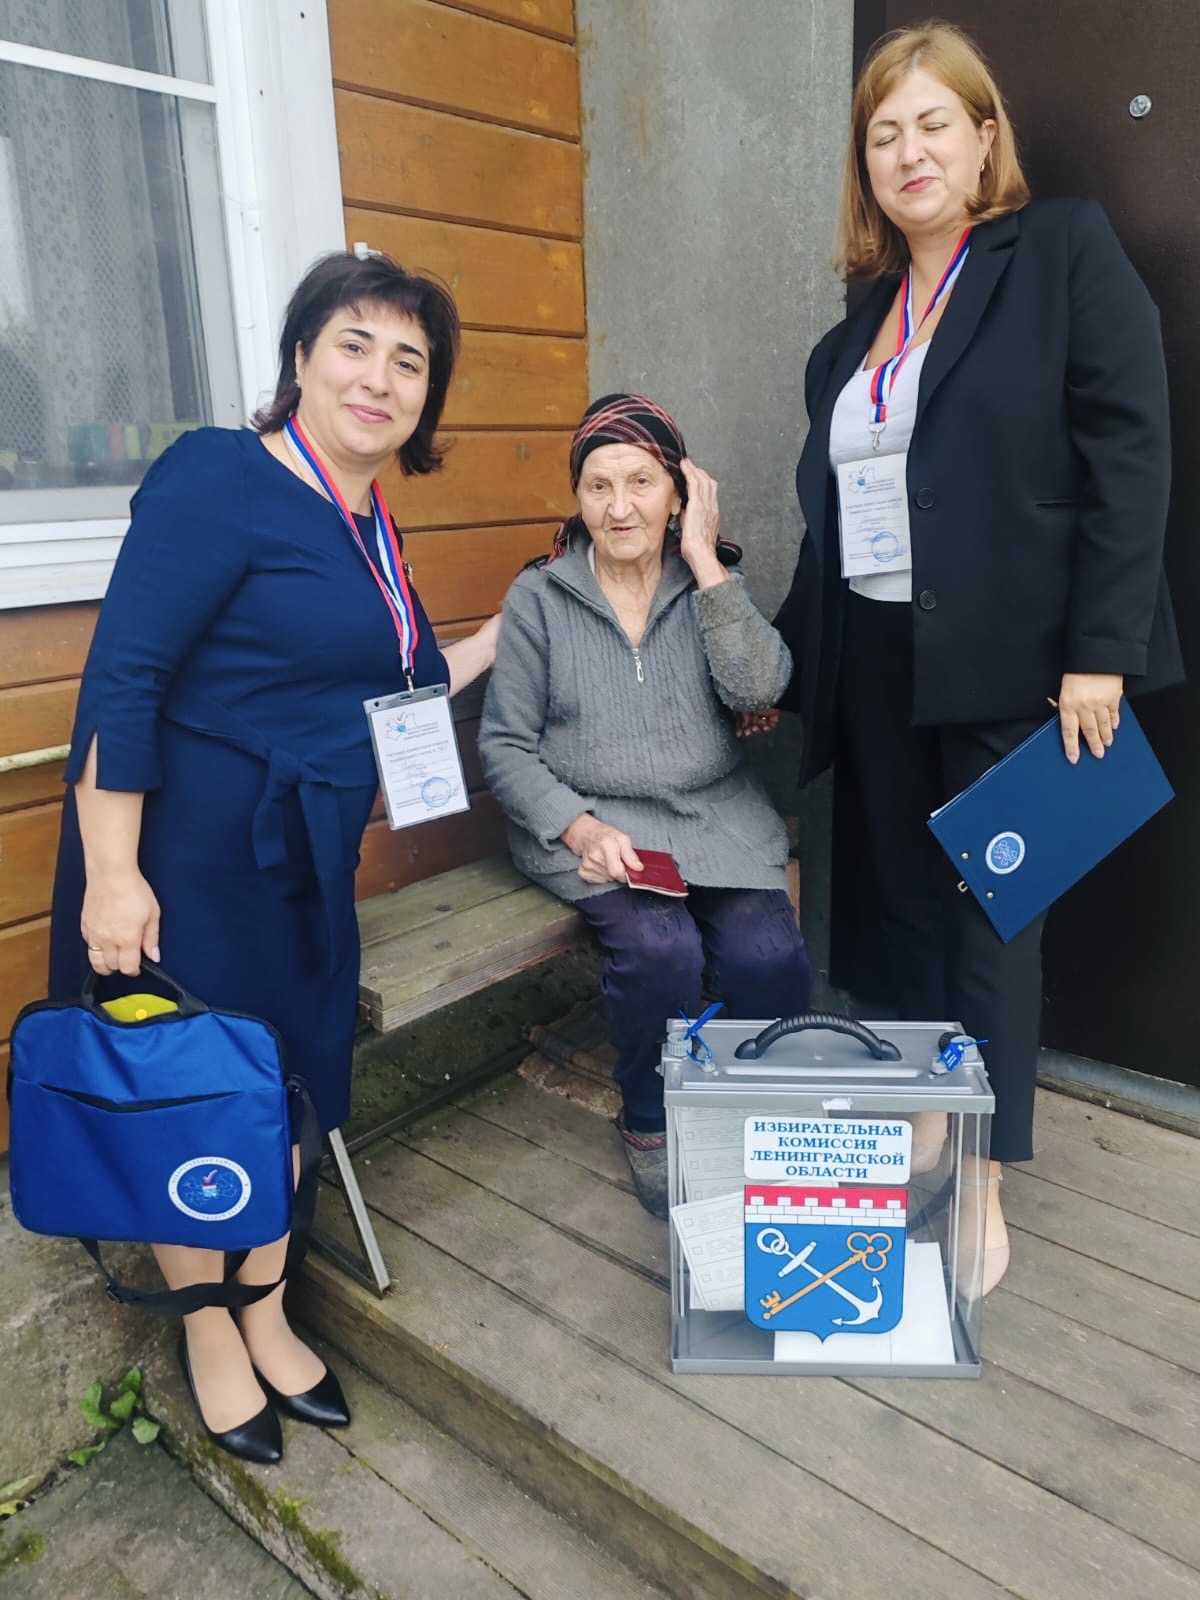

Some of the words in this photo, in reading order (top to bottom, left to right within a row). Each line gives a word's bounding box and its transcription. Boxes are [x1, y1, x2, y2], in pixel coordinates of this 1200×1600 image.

[754, 1121, 903, 1136] ИЗБИРАТЕЛЬНАЯ
[778, 1137, 877, 1150] КОМИССИЯ
[750, 1150, 904, 1165] ЛЕНИНГРАДСКОЙ
[785, 1165, 868, 1178] ОБЛАСТИ
